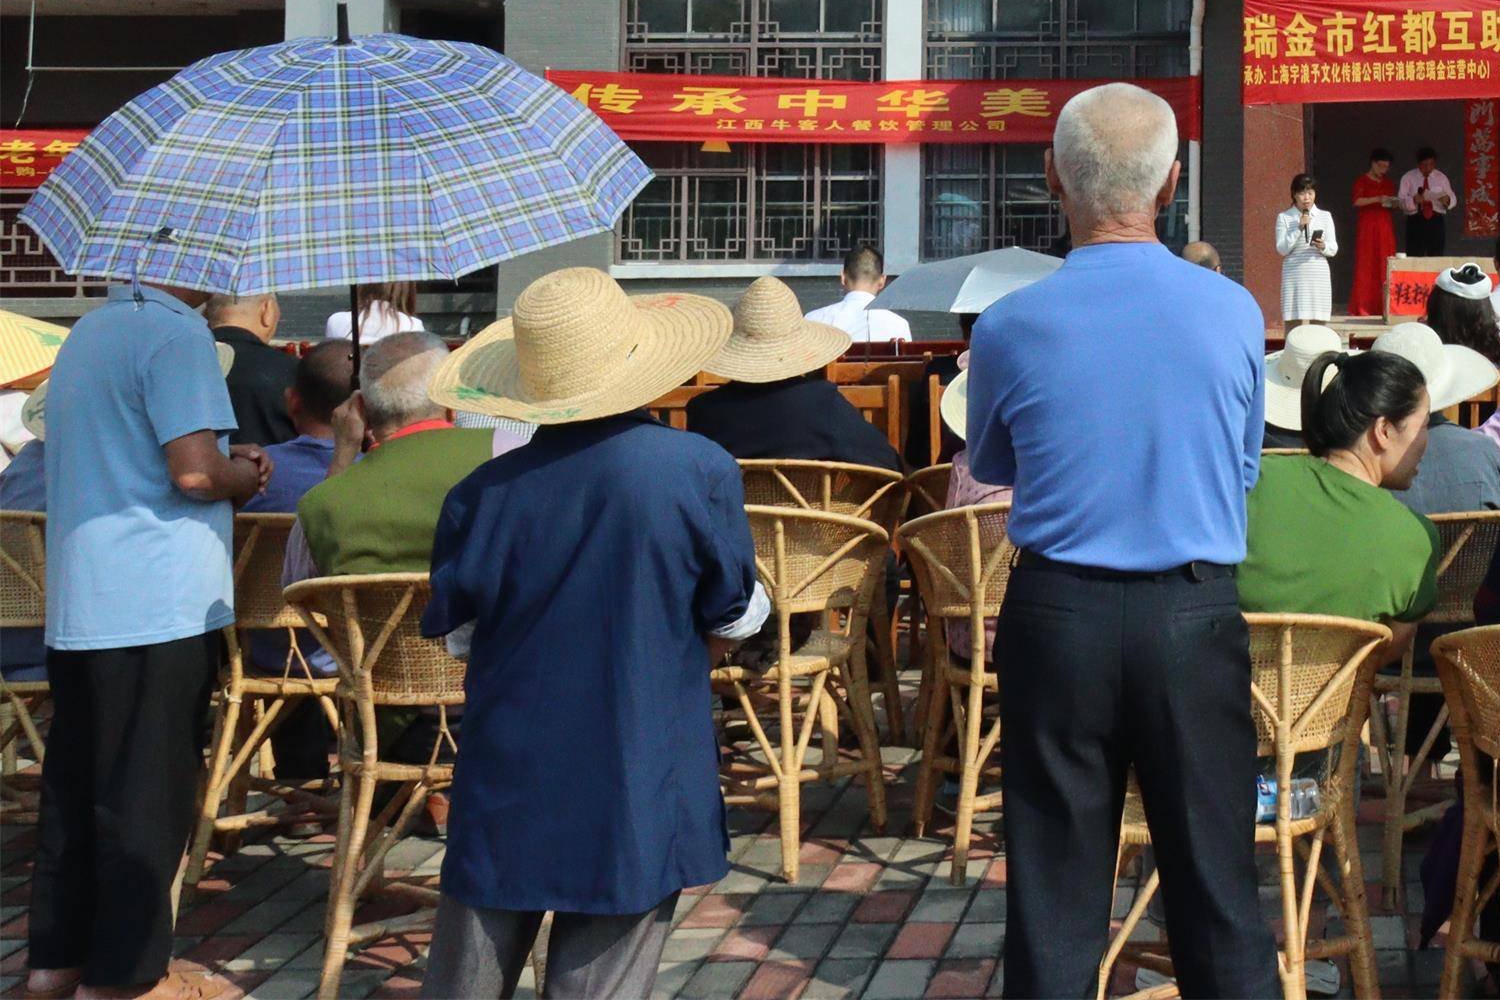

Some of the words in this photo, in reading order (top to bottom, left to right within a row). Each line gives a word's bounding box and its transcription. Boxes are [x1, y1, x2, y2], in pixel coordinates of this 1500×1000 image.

[716, 118, 1006, 131] 江西牛客人餐饮管理公司
